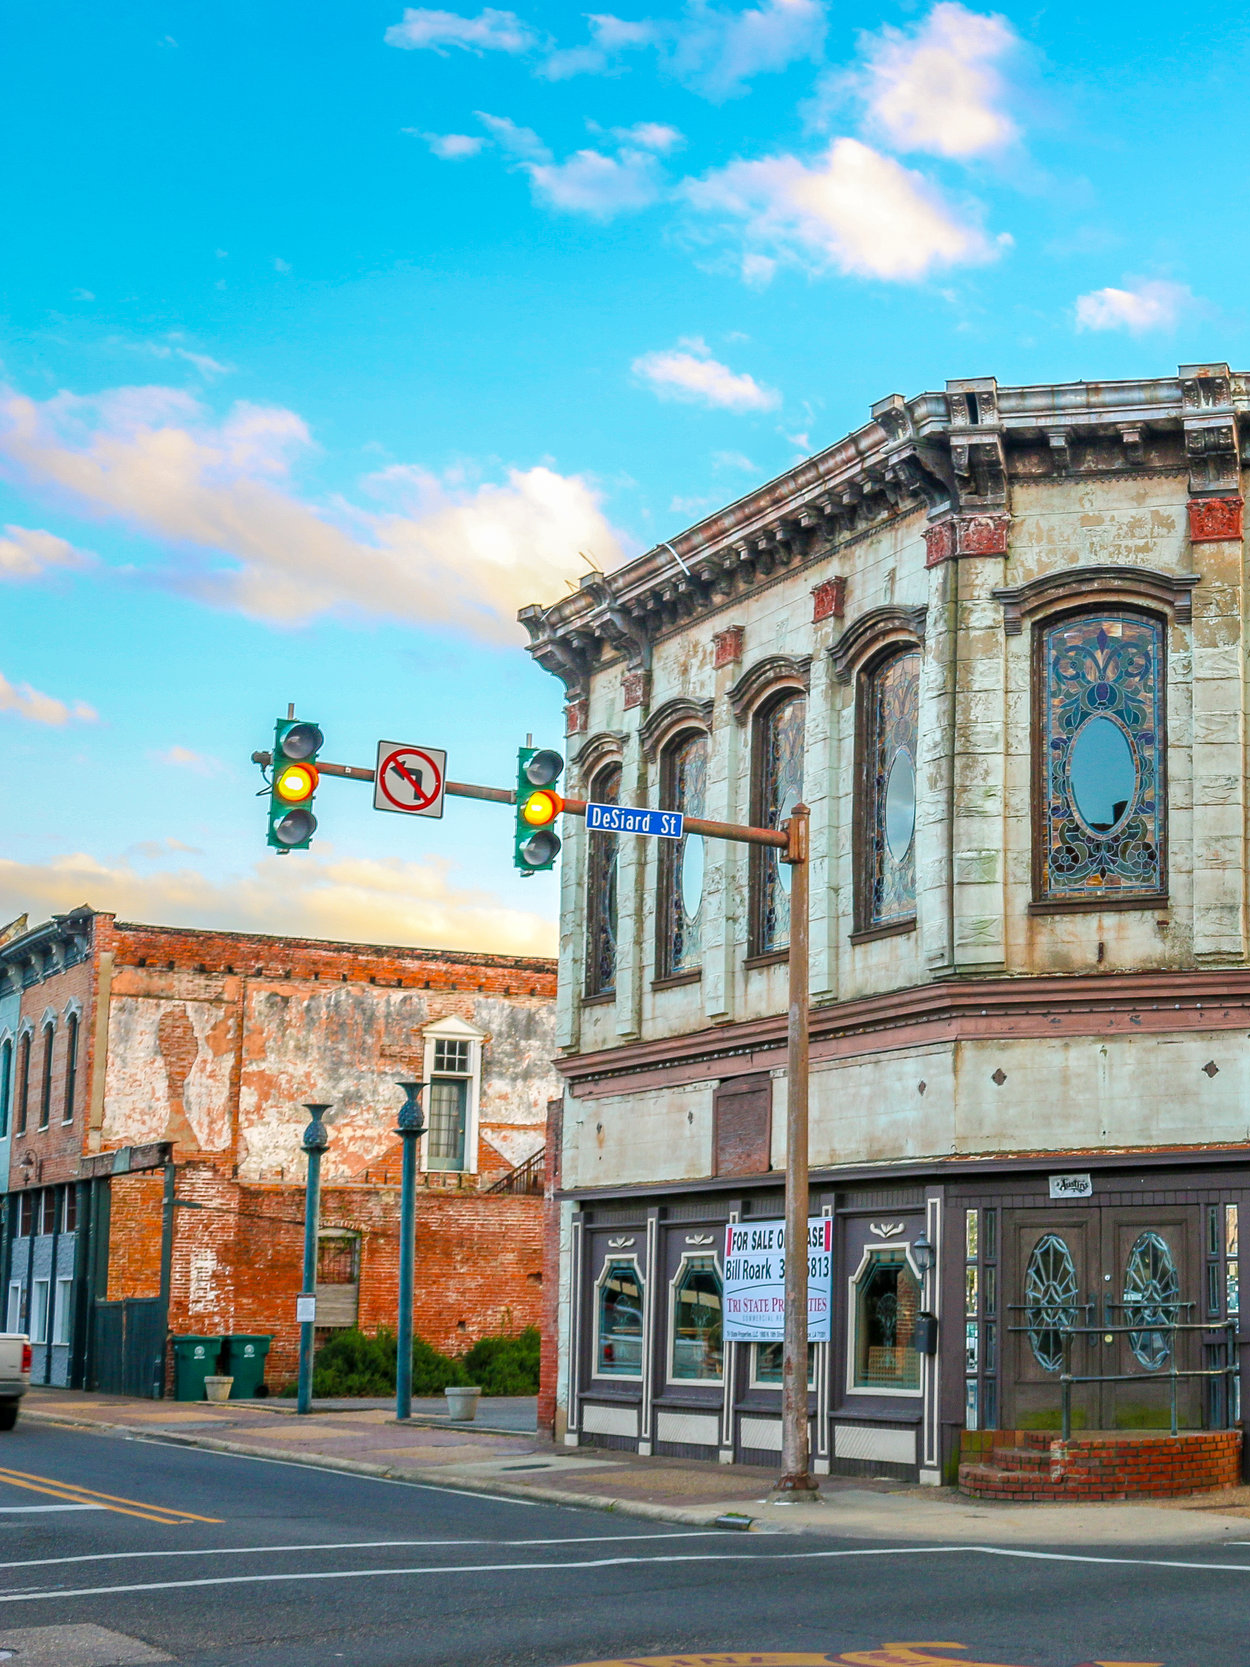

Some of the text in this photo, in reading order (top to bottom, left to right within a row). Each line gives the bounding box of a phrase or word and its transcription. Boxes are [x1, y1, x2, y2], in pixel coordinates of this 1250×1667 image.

[592, 807, 676, 835] DeSiard St
[732, 1231, 748, 1251] FOR
[751, 1230, 774, 1251] SALE
[777, 1228, 786, 1249] O
[726, 1259, 741, 1280] Bill
[743, 1258, 772, 1280] Roark
[743, 1298, 769, 1312] STATE
